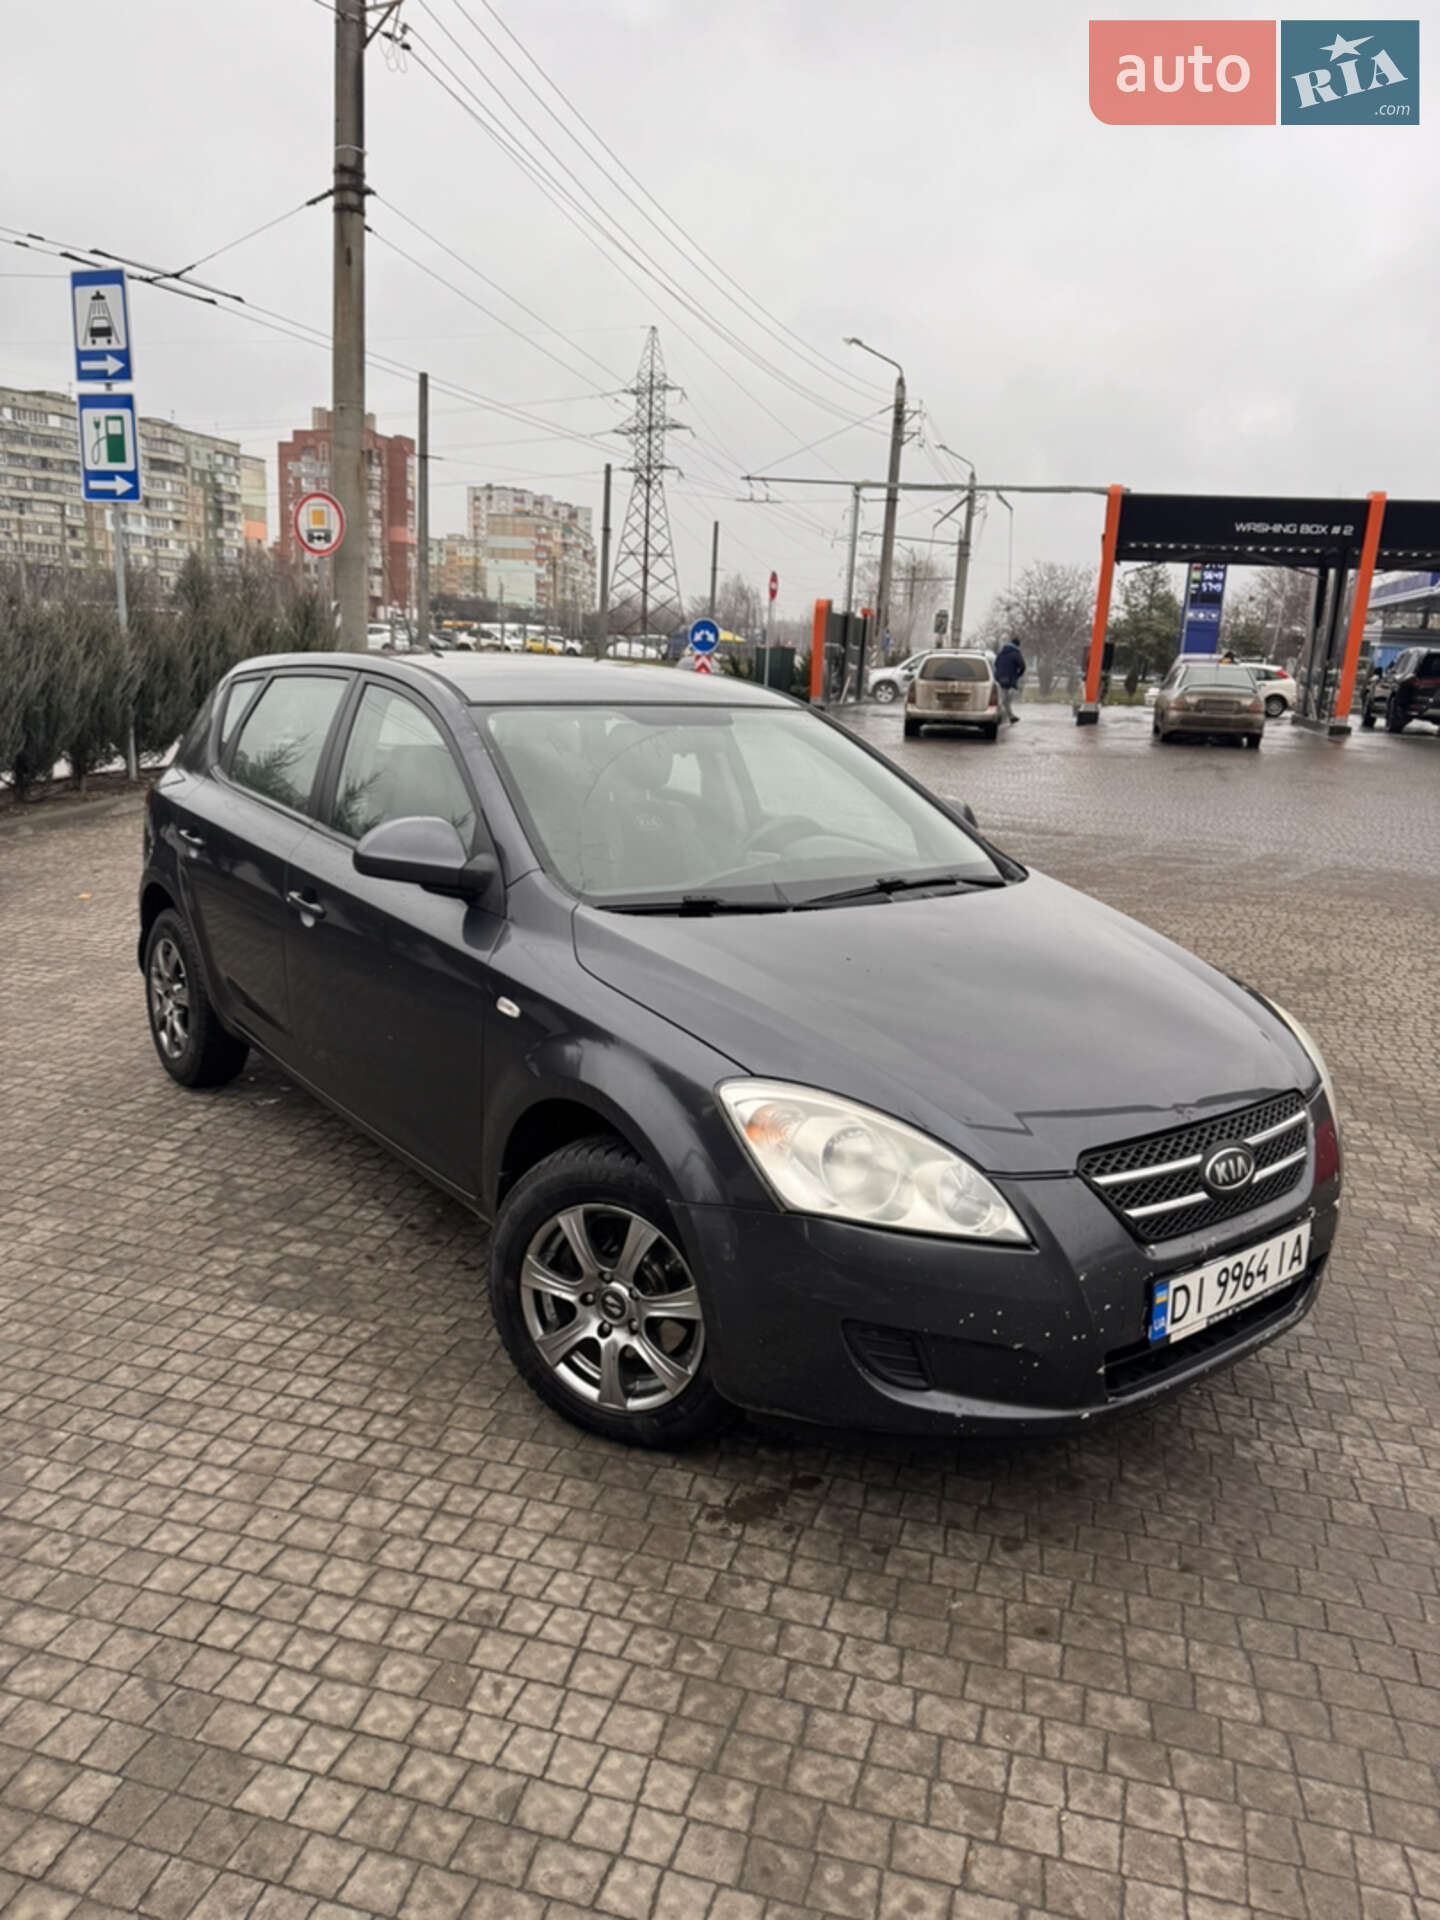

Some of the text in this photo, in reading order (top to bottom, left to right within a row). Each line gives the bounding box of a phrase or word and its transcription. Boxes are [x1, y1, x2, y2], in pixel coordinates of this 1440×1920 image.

[1235, 521, 1297, 534] WASHING
[1300, 523, 1328, 535] BOX
[1343, 524, 1355, 536] 2
[1214, 1156, 1249, 1184] KIA
[1170, 1277, 1204, 1325] DI
[1216, 1248, 1269, 1306] 9964
[1278, 1233, 1303, 1277] IA
